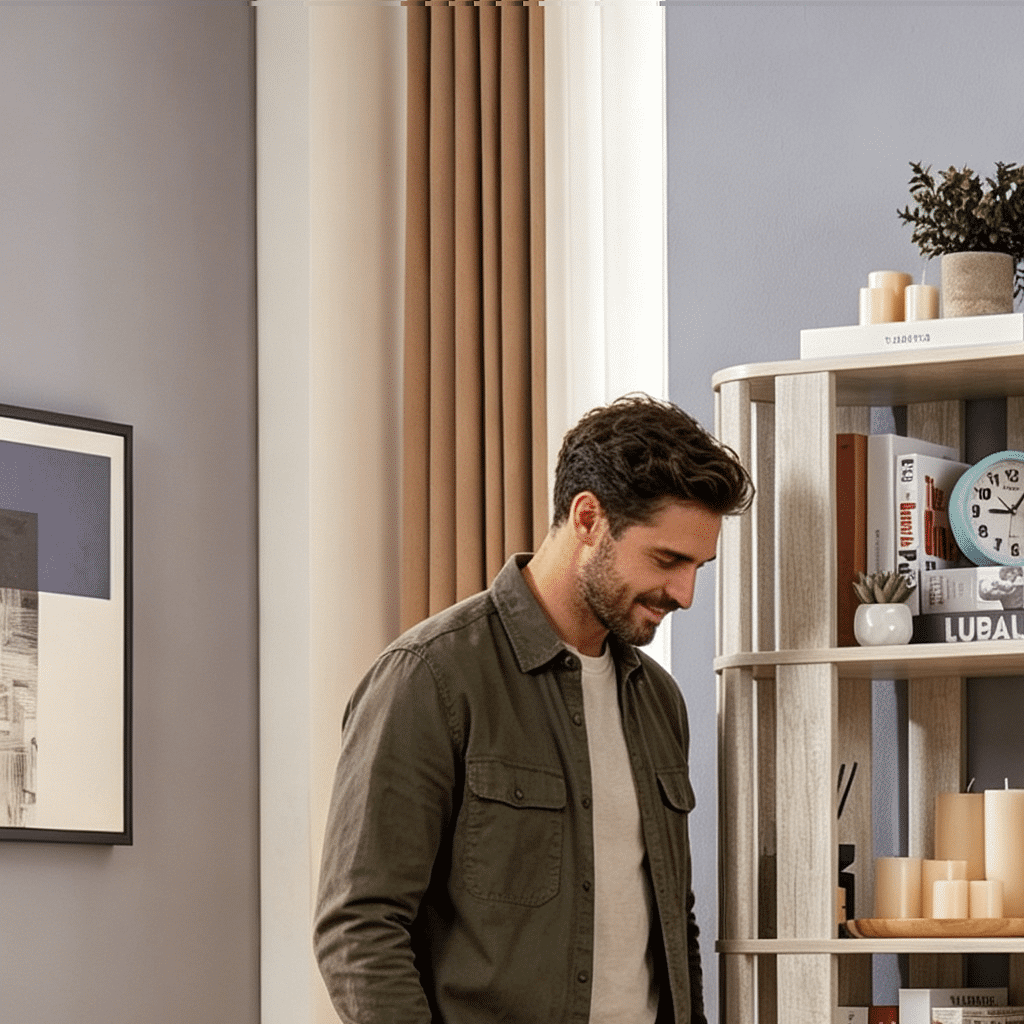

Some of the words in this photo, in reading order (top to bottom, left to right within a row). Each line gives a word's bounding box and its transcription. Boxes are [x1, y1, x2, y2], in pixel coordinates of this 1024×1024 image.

[974, 487, 991, 500] 10
[972, 504, 980, 518] 9
[978, 525, 988, 538] 8
[1011, 543, 1019, 556] 6
